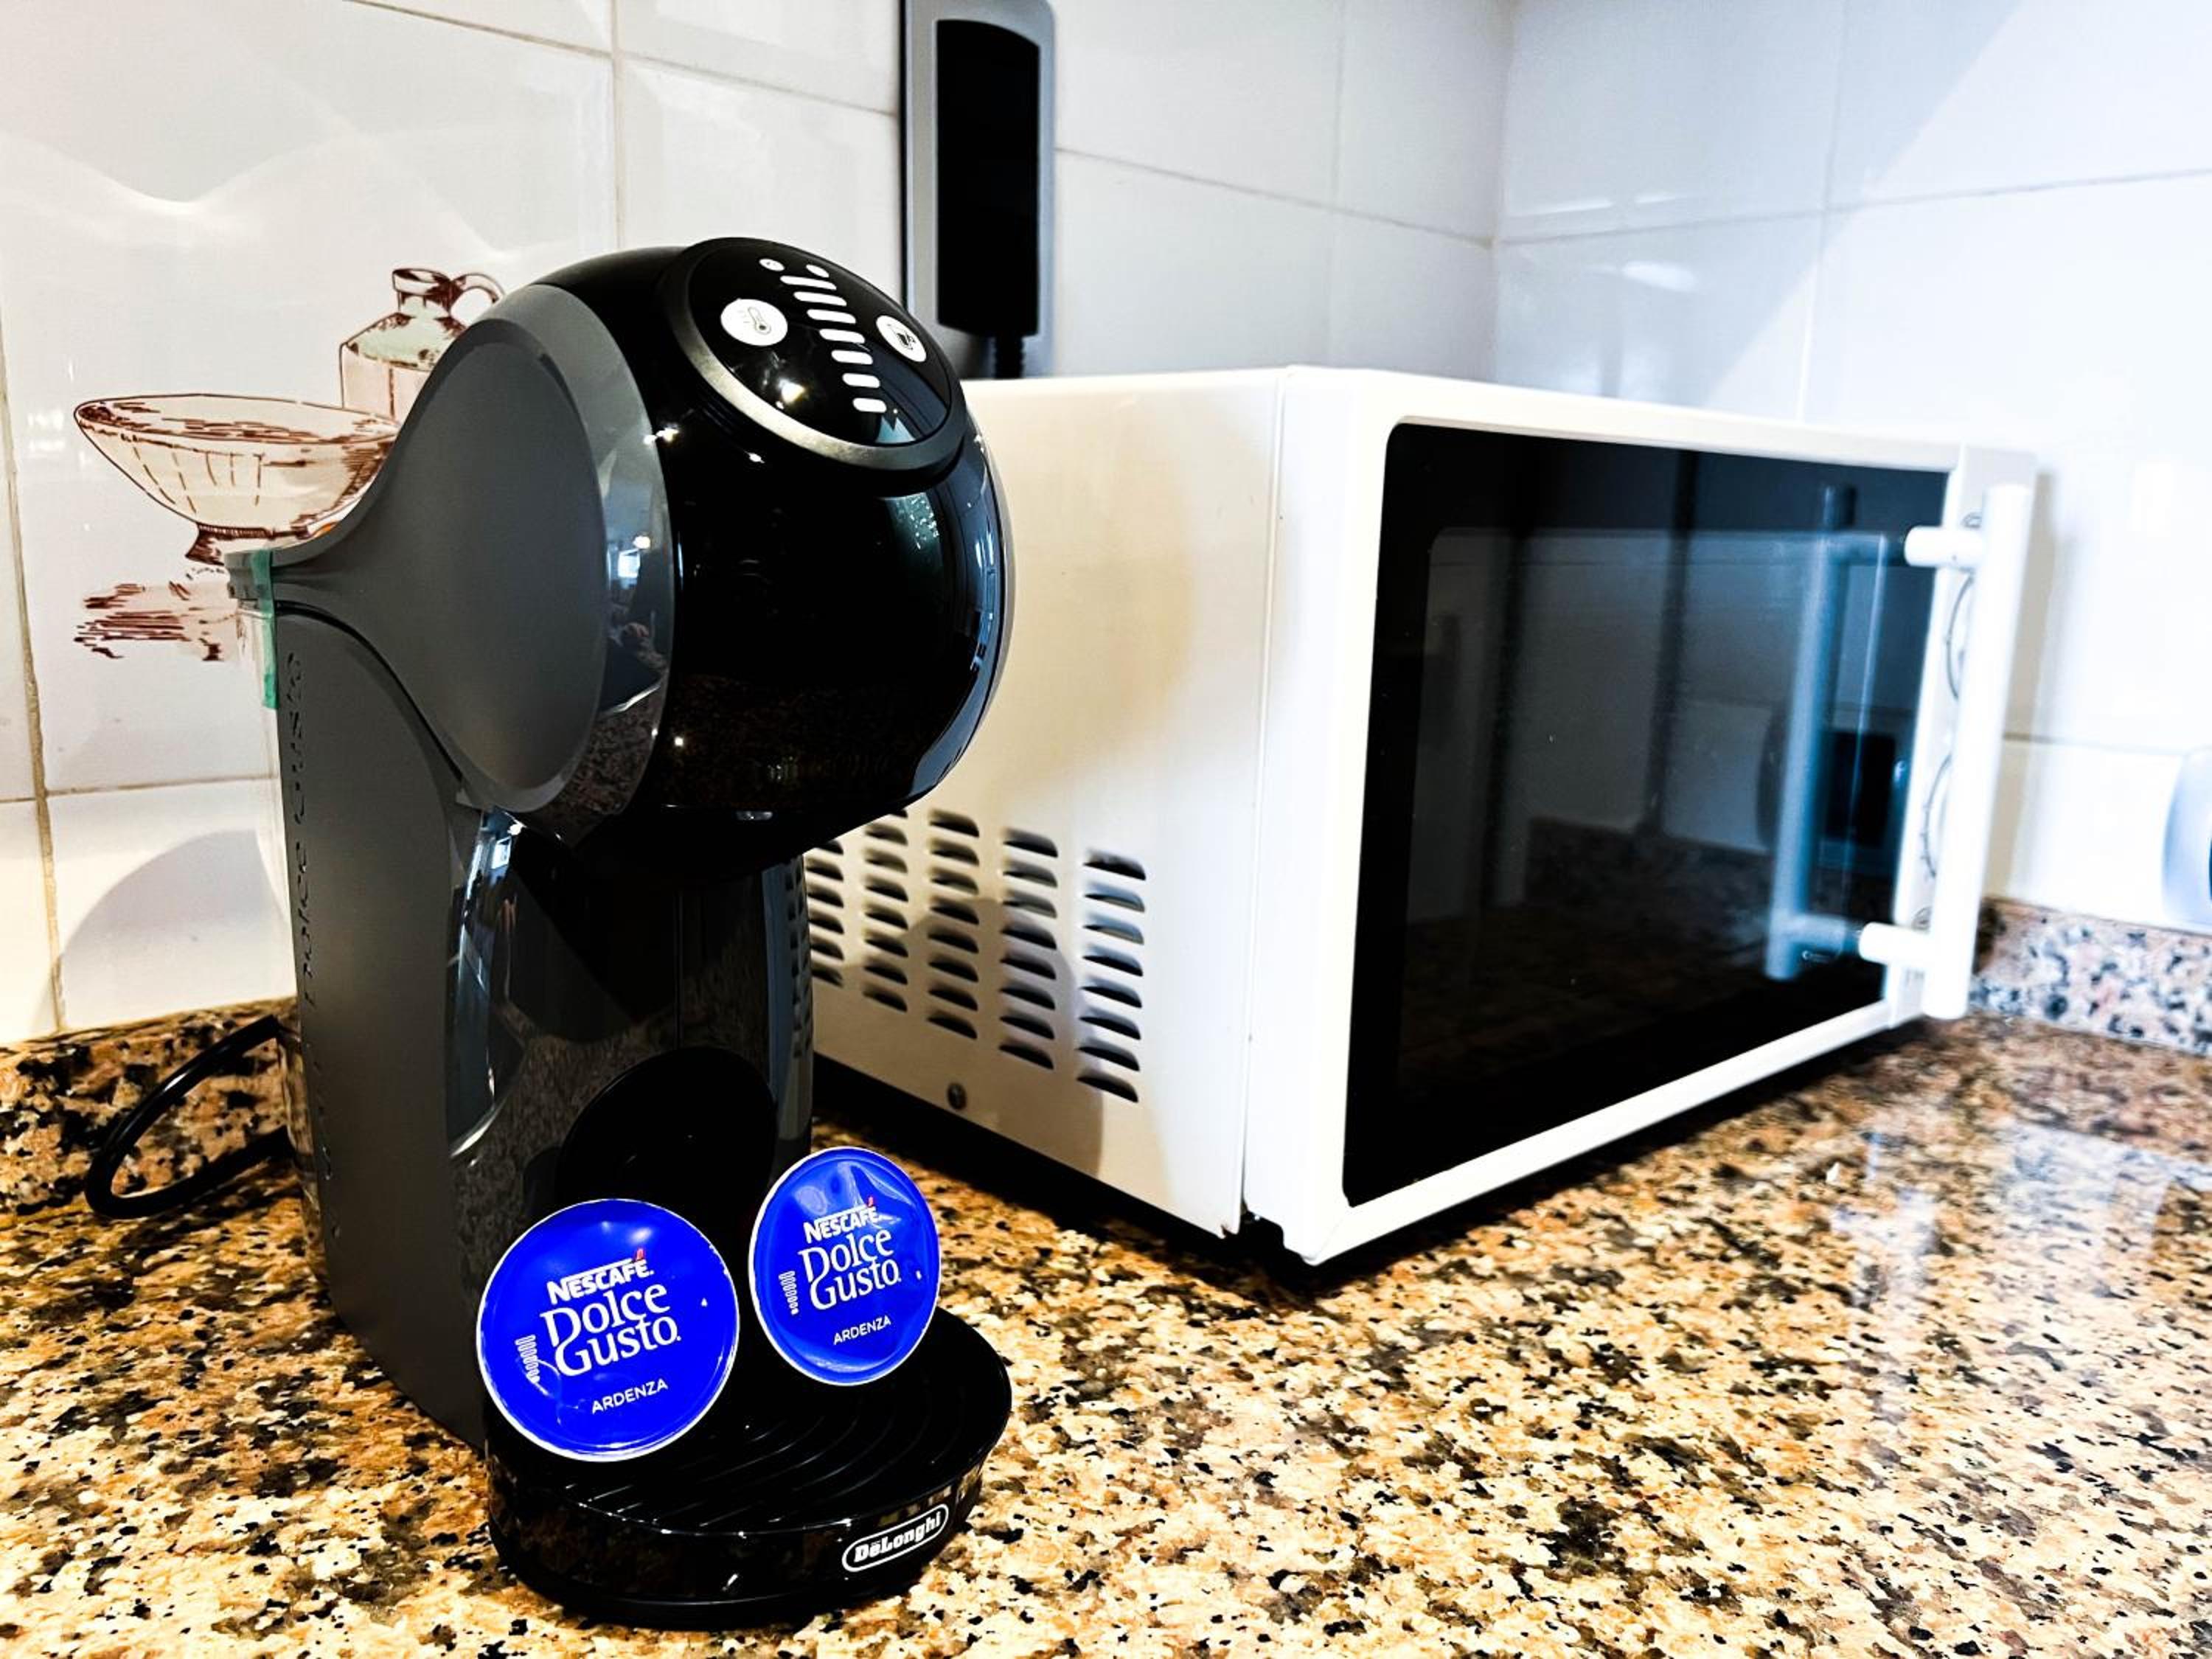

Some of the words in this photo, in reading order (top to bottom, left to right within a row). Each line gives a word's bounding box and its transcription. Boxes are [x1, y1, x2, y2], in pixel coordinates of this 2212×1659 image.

[798, 1229, 894, 1283] Dolce
[810, 1259, 902, 1310] Gusto
[539, 1283, 670, 1348] Dolce
[833, 1315, 892, 1346] ARDENZA
[554, 1316, 681, 1377] Gusto
[592, 1378, 669, 1414] ARDENZA
